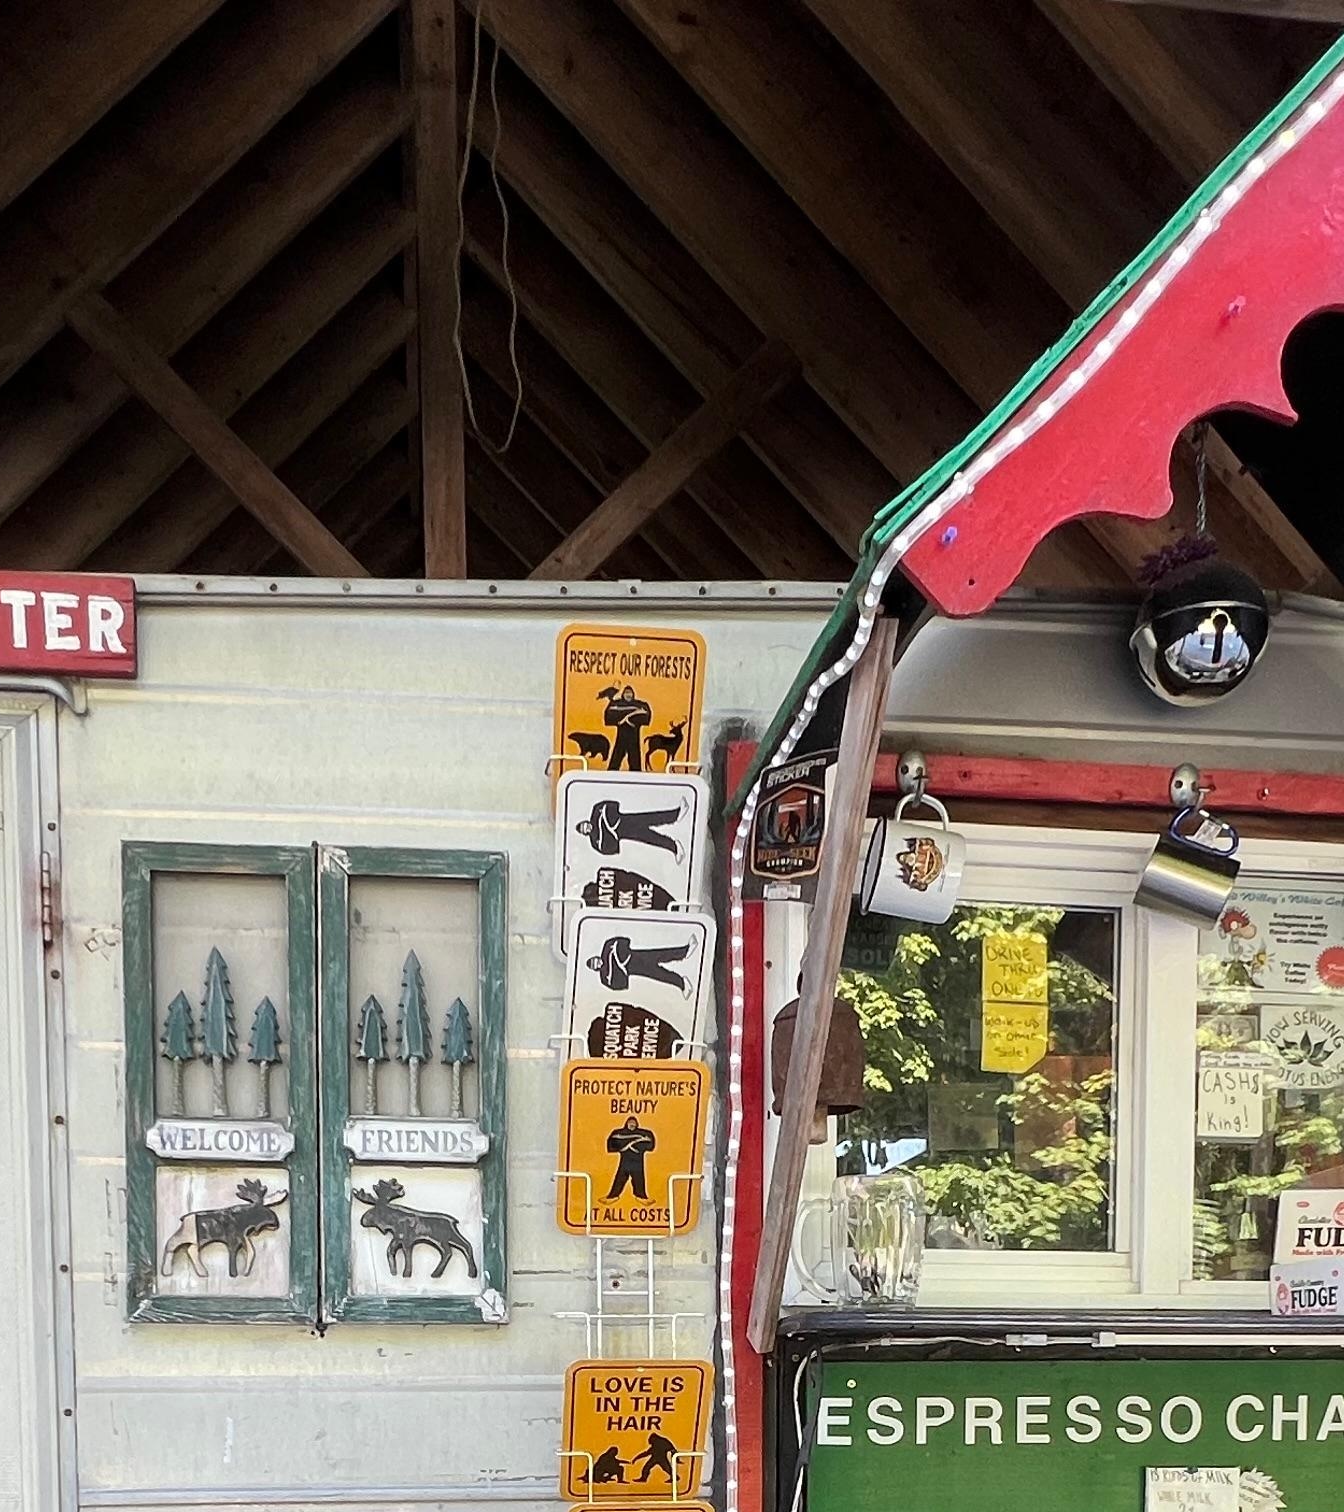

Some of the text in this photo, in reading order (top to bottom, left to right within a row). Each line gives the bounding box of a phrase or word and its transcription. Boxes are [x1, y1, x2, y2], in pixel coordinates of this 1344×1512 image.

[570, 649, 692, 681] RESPECT OUR FORESTS
[986, 945, 1033, 961] DRIVE
[623, 1025, 641, 1057] PARK
[574, 1078, 697, 1097] PROTECT NATURE'S
[610, 1098, 659, 1114] BEAUTY
[158, 1128, 282, 1151] WELCOME
[361, 1129, 474, 1151] FRIENDS
[603, 1207, 626, 1222] ALL
[630, 1207, 671, 1223] COSTS
[1291, 1286, 1338, 1309] FUDGE
[590, 1376, 684, 1393] LOVE IS
[596, 1396, 675, 1412] IN THE
[607, 1415, 662, 1431] HAIR
[817, 1395, 1202, 1445] ESPRESSO
